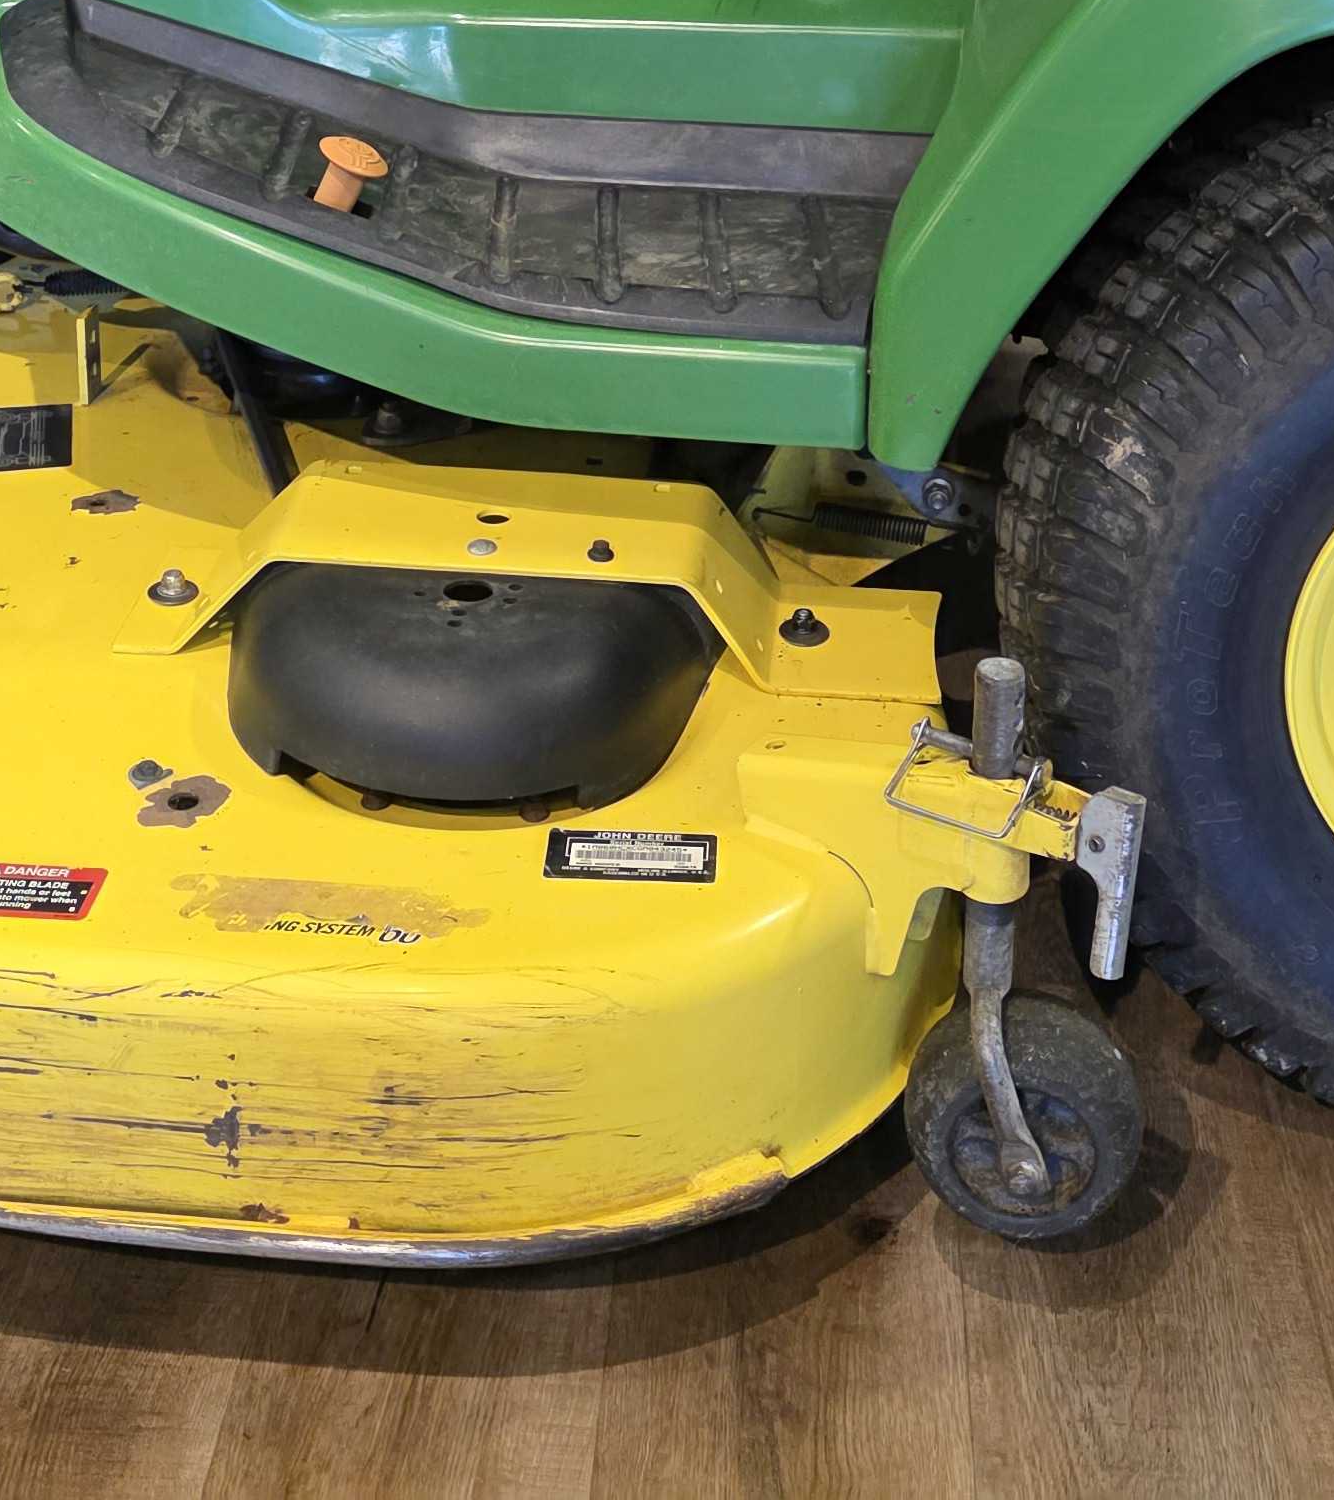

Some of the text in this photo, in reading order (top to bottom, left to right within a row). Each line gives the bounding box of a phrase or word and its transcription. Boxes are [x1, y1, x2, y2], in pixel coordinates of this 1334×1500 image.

[593, 832, 682, 841] JOHN DEERE
[4, 866, 70, 878] DANGER
[28, 879, 70, 889] BLADE
[6, 887, 36, 895] hands
[300, 921, 375, 937] SYSTEM
